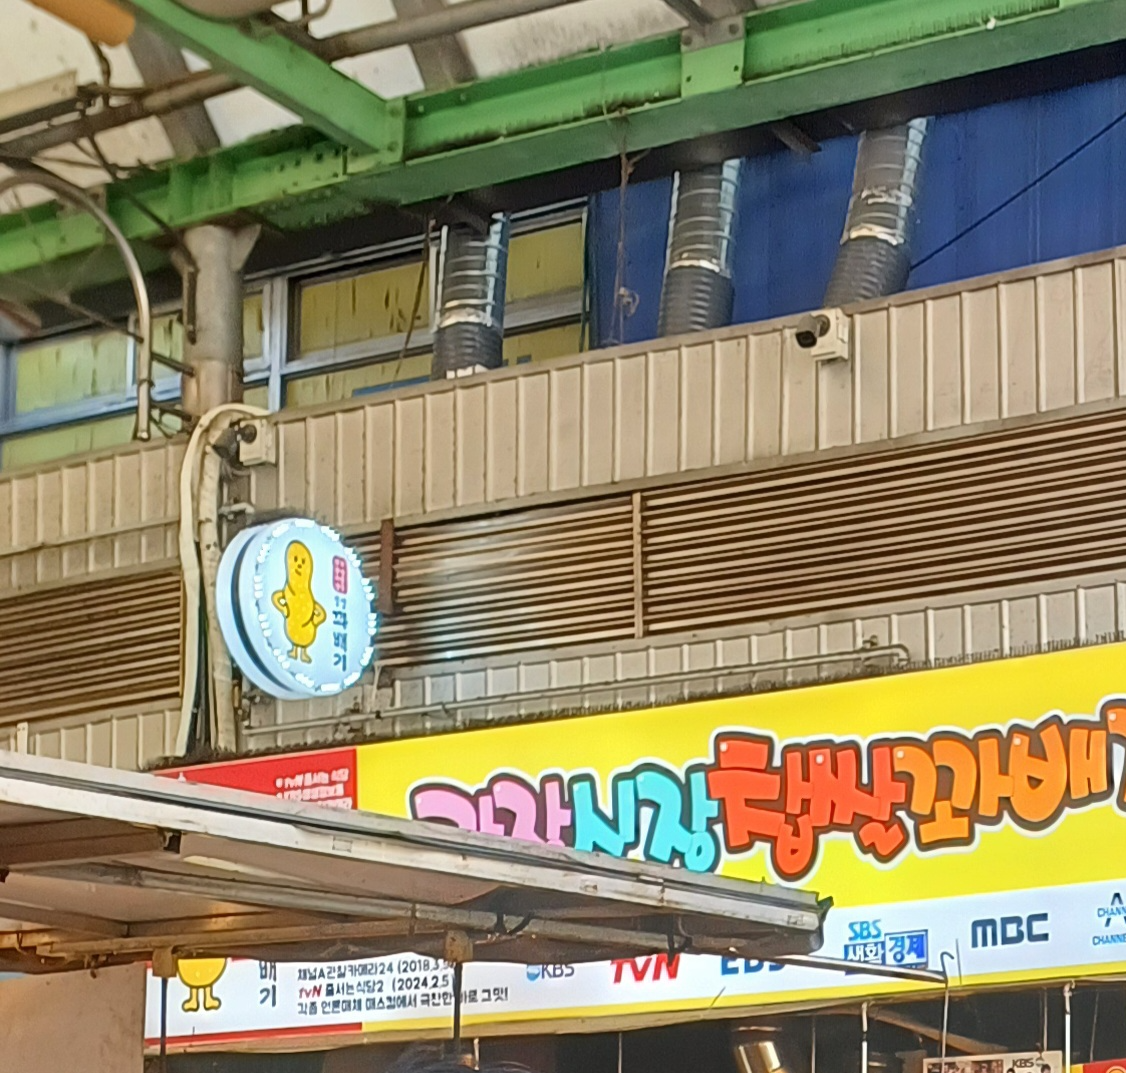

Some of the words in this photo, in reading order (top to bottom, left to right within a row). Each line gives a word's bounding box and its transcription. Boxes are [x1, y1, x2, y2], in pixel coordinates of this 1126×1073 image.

[848, 918, 883, 941] SBS
[971, 912, 1050, 950] MBC
[541, 964, 575, 979] KBS
